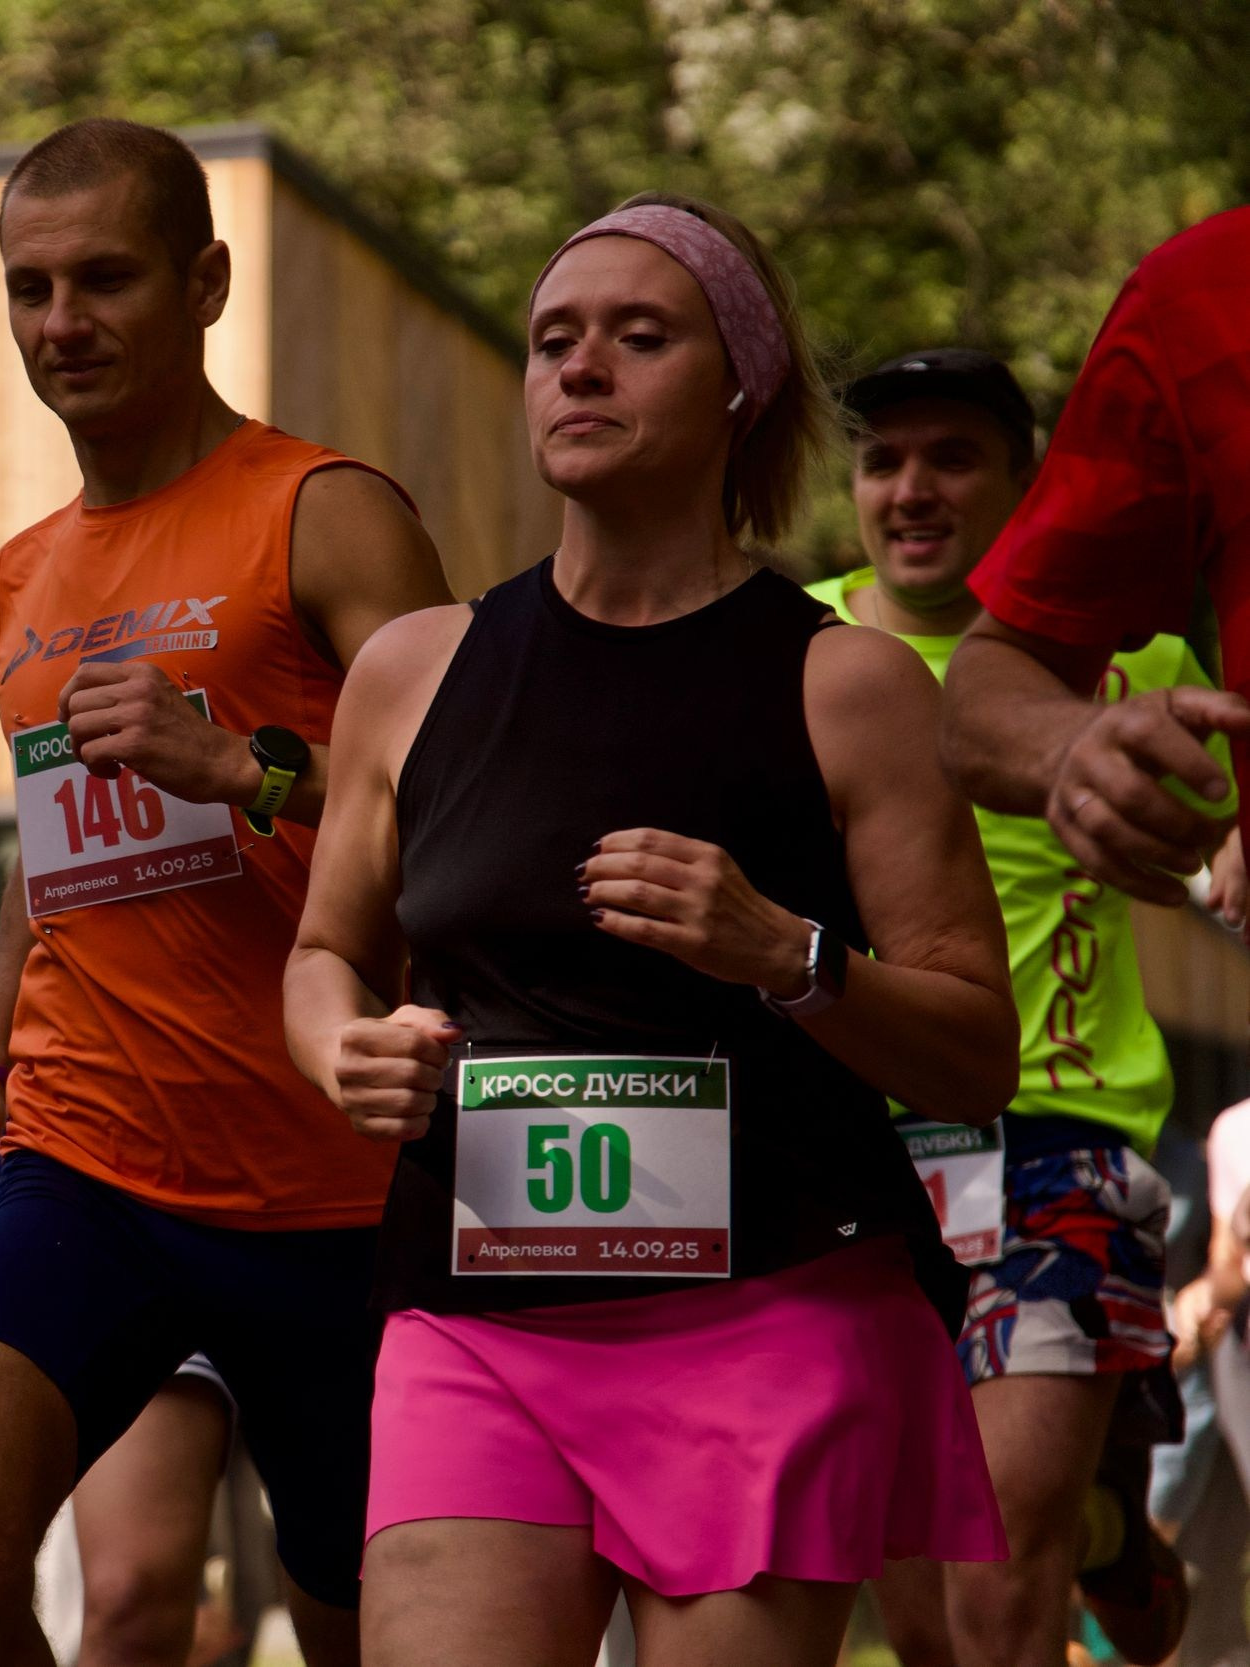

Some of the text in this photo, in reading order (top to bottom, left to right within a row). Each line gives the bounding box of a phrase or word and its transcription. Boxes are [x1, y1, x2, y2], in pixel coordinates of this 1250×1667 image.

[41, 596, 228, 662] DEMIX
[145, 631, 212, 652] TRAINING
[28, 733, 74, 765] КРОС
[53, 762, 166, 856] 146
[44, 851, 214, 900] Апрелевка 14.09.25
[481, 1072, 698, 1101] КРОСС ДУБКИ
[907, 1129, 983, 1158] ДУБКИ
[526, 1122, 632, 1214] 50
[478, 1240, 700, 1260] Апрелевка 14.09.25
